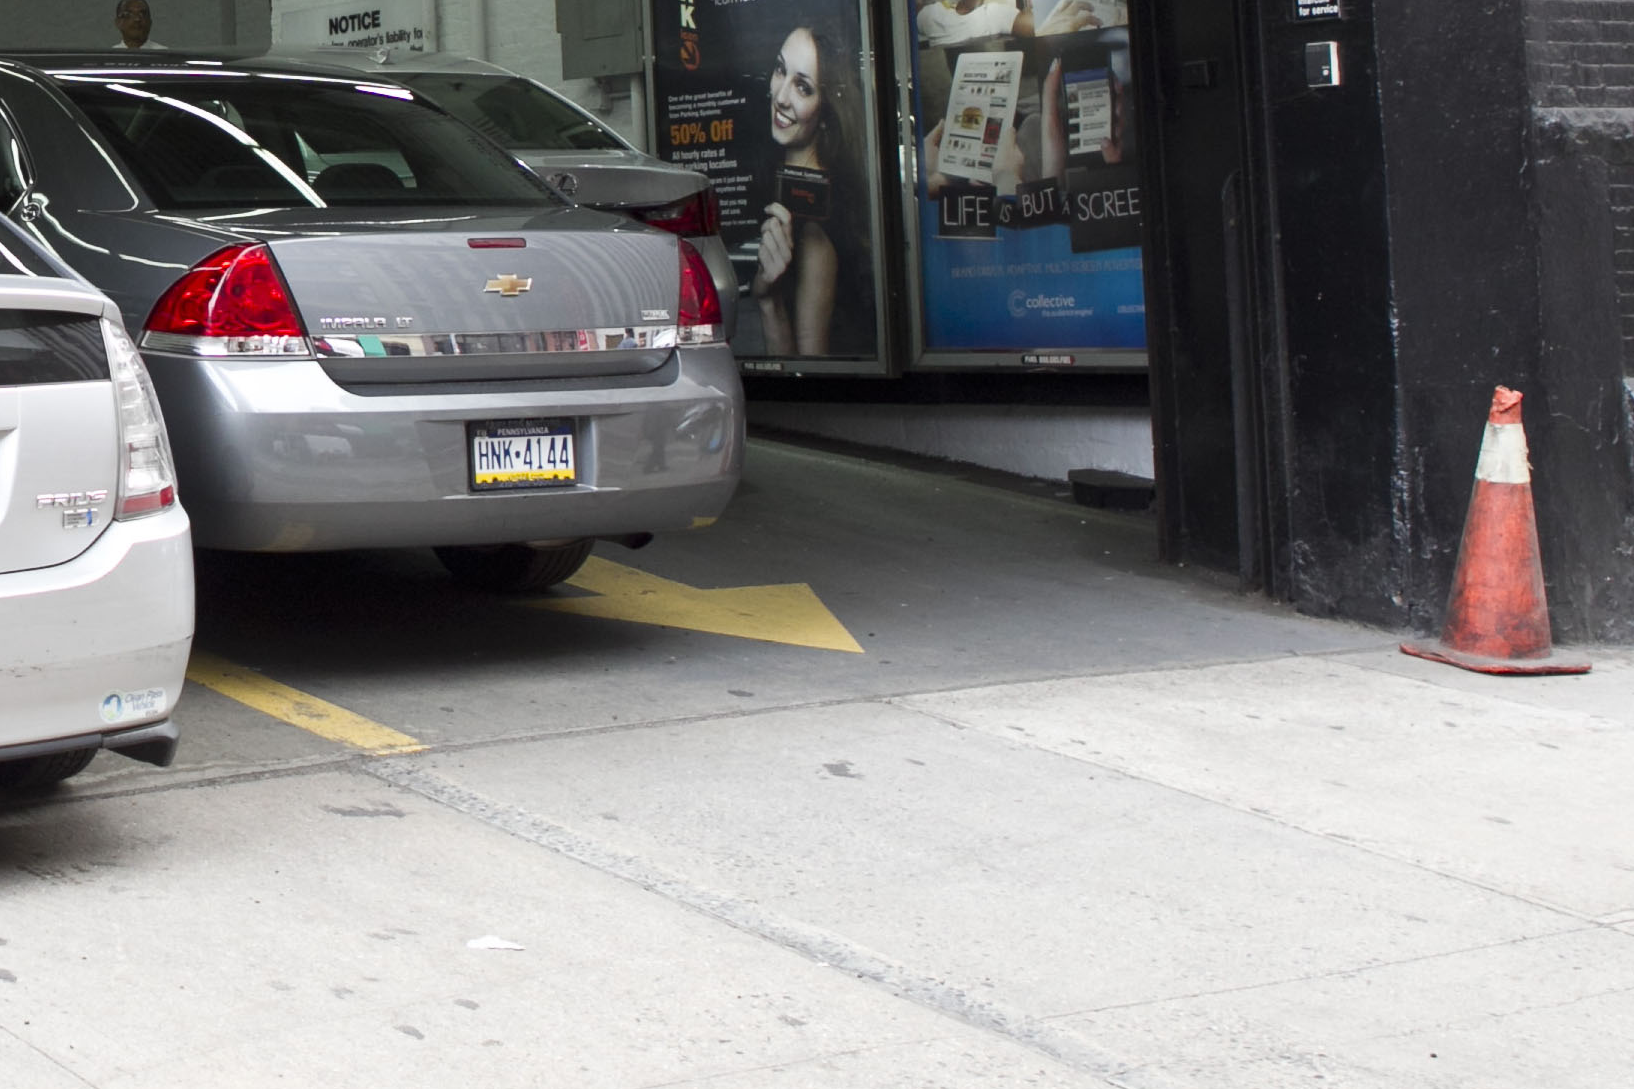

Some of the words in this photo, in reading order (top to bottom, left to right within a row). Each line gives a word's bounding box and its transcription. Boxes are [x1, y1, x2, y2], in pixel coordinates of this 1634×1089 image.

[1299, 7, 1310, 16] for
[1312, 4, 1338, 15] service
[329, 10, 381, 36] NOTICE
[386, 29, 411, 44] liability
[670, 122, 707, 146] 50%
[710, 119, 734, 142] Off
[943, 195, 991, 227] LIFE
[999, 203, 1012, 223] IS
[1022, 187, 1055, 217] BUT
[1077, 187, 1141, 221] SCREE
[1026, 294, 1076, 309] collective
[320, 316, 387, 330] IMPALA
[396, 316, 414, 329] LT
[497, 426, 551, 437] PENNSYLVANIA
[36, 489, 108, 509] PRIUS
